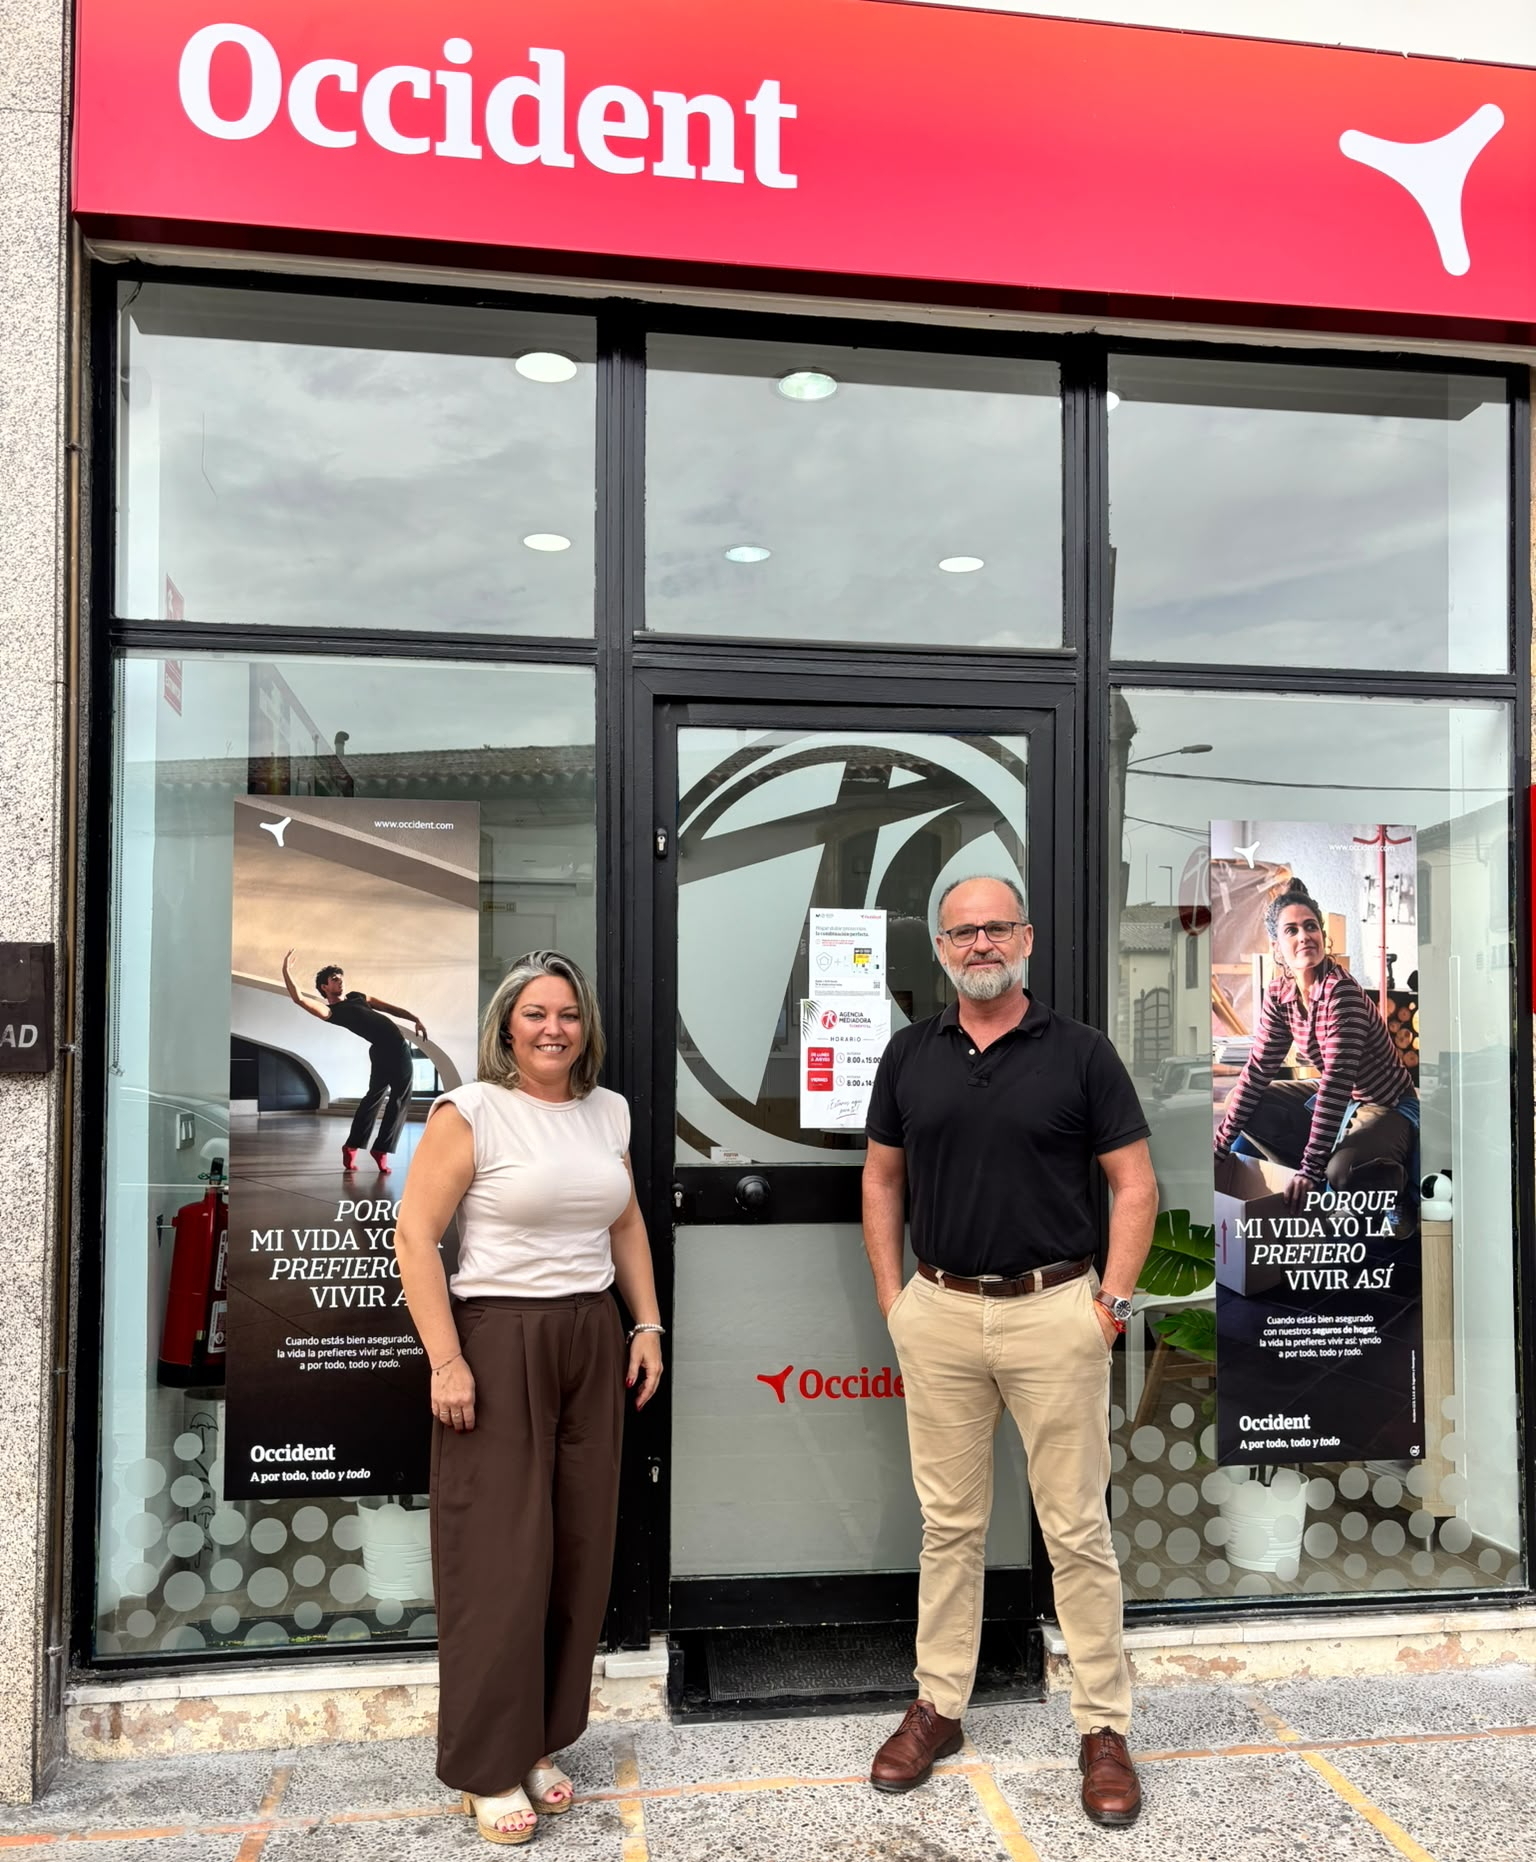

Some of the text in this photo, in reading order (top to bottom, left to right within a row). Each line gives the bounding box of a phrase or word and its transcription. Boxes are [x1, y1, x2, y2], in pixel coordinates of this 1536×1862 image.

[179, 24, 797, 188] Occident
[374, 820, 454, 830] www.occident.com
[0, 1024, 38, 1048] AD
[1304, 1190, 1398, 1212] PORQUE
[1234, 1216, 1396, 1240] MI VIDA YO LA
[251, 1229, 284, 1252] MI
[291, 1229, 360, 1251] VIDA
[1251, 1243, 1366, 1264] PREFIERO
[1285, 1263, 1394, 1290] VIVIR ASÍ
[310, 1286, 386, 1308] VIVIR
[1267, 1314, 1373, 1324] Cuando estás bien asegurado
[286, 1335, 415, 1345] Cuando estás bien asegurado,
[1312, 1328, 1342, 1336] seguros
[1260, 1339, 1266, 1347] la
[1285, 1338, 1292, 1346] la
[1293, 1338, 1326, 1347] prefieres
[1328, 1337, 1344, 1345] vivir
[1359, 1336, 1381, 1345] yendo
[277, 1347, 423, 1358] la vida la prefieres vivir así: yendo
[1299, 1349, 1318, 1357] todo,
[1320, 1348, 1337, 1356] todo
[1344, 1348, 1362, 1356] todo.
[308, 1363, 322, 1371] por
[325, 1361, 346, 1369] todo,
[349, 1360, 369, 1368] todo
[379, 1359, 400, 1368] todo.
[1239, 1414, 1310, 1431] Occident
[1240, 1436, 1340, 1450] A por todo, todo y todo
[251, 1444, 335, 1462] Occident
[250, 1468, 370, 1483] A por todo, todo y todo
